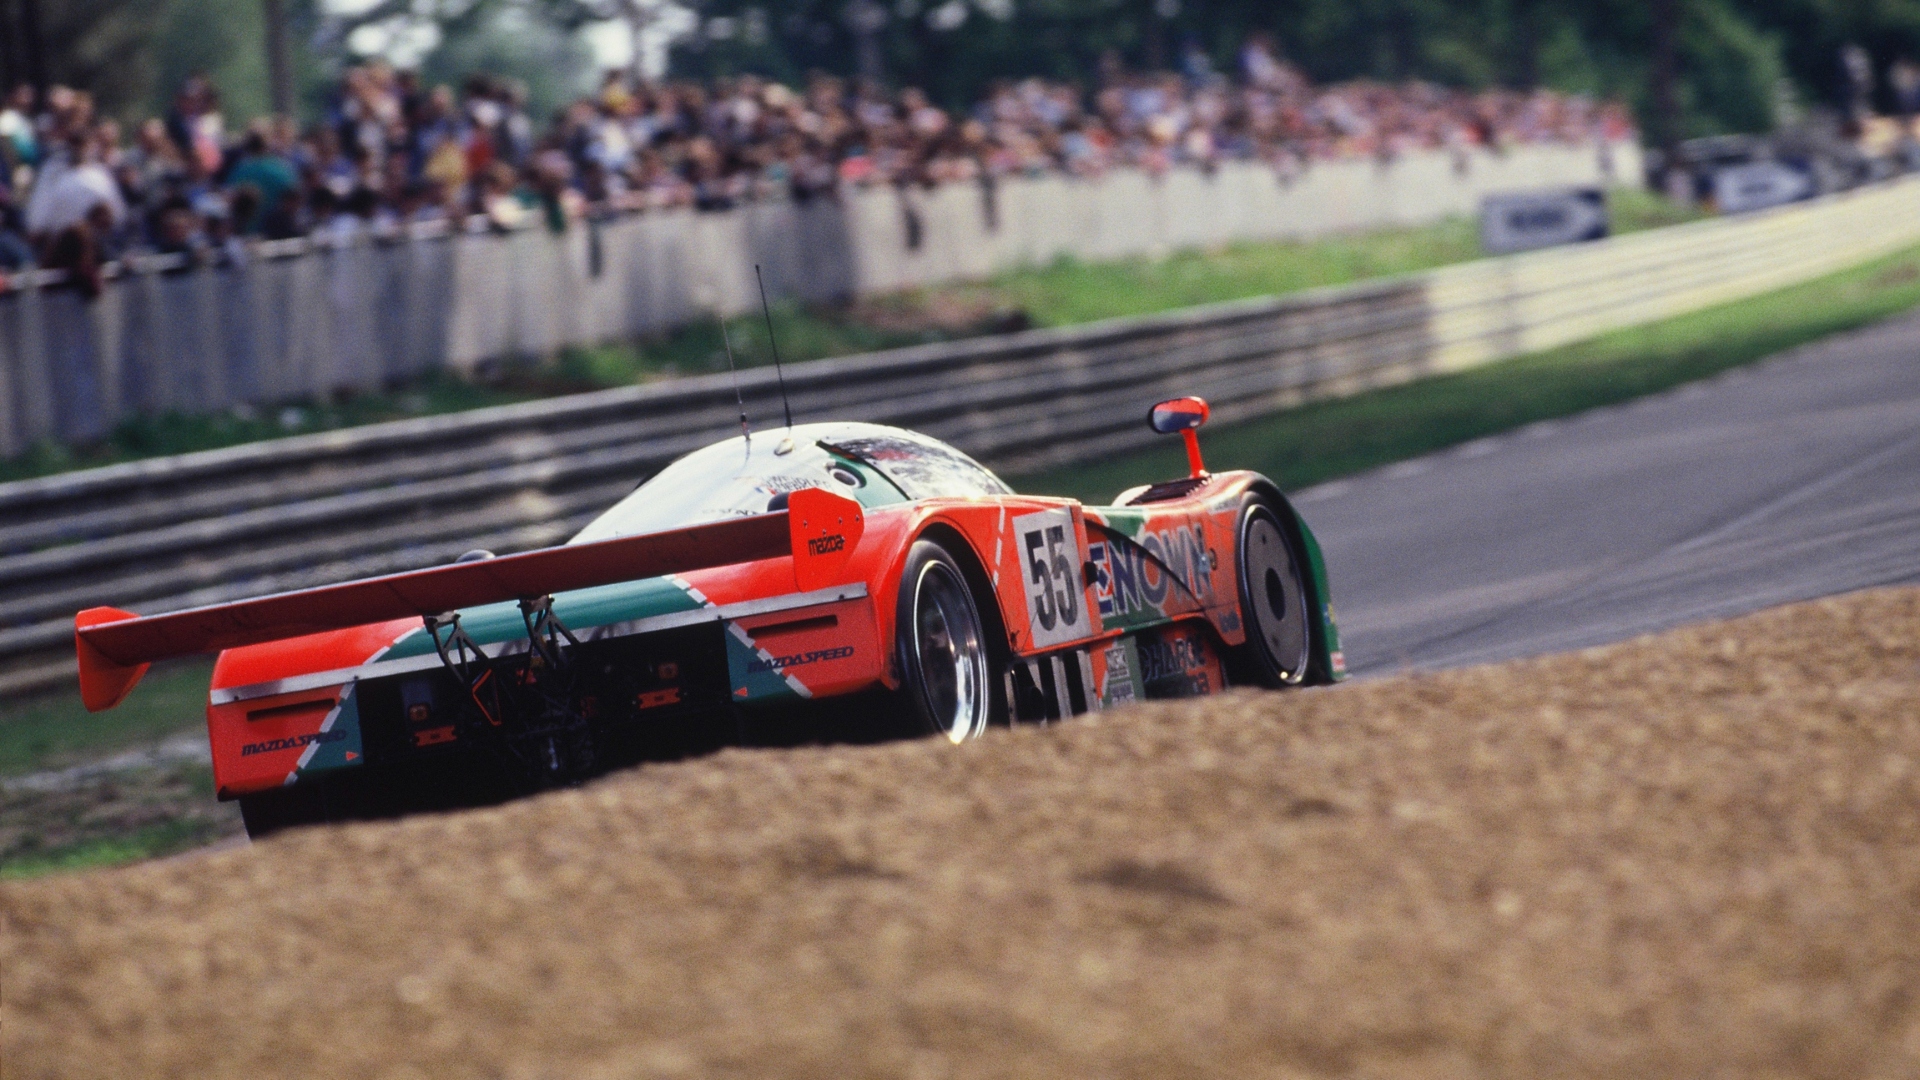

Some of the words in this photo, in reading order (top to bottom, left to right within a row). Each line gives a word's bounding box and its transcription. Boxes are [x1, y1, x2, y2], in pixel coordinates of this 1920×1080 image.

[807, 534, 843, 557] mazda
[1024, 525, 1078, 631] 55
[748, 646, 854, 673] MAZDASPEED
[242, 729, 347, 757] MAZDASPEED
